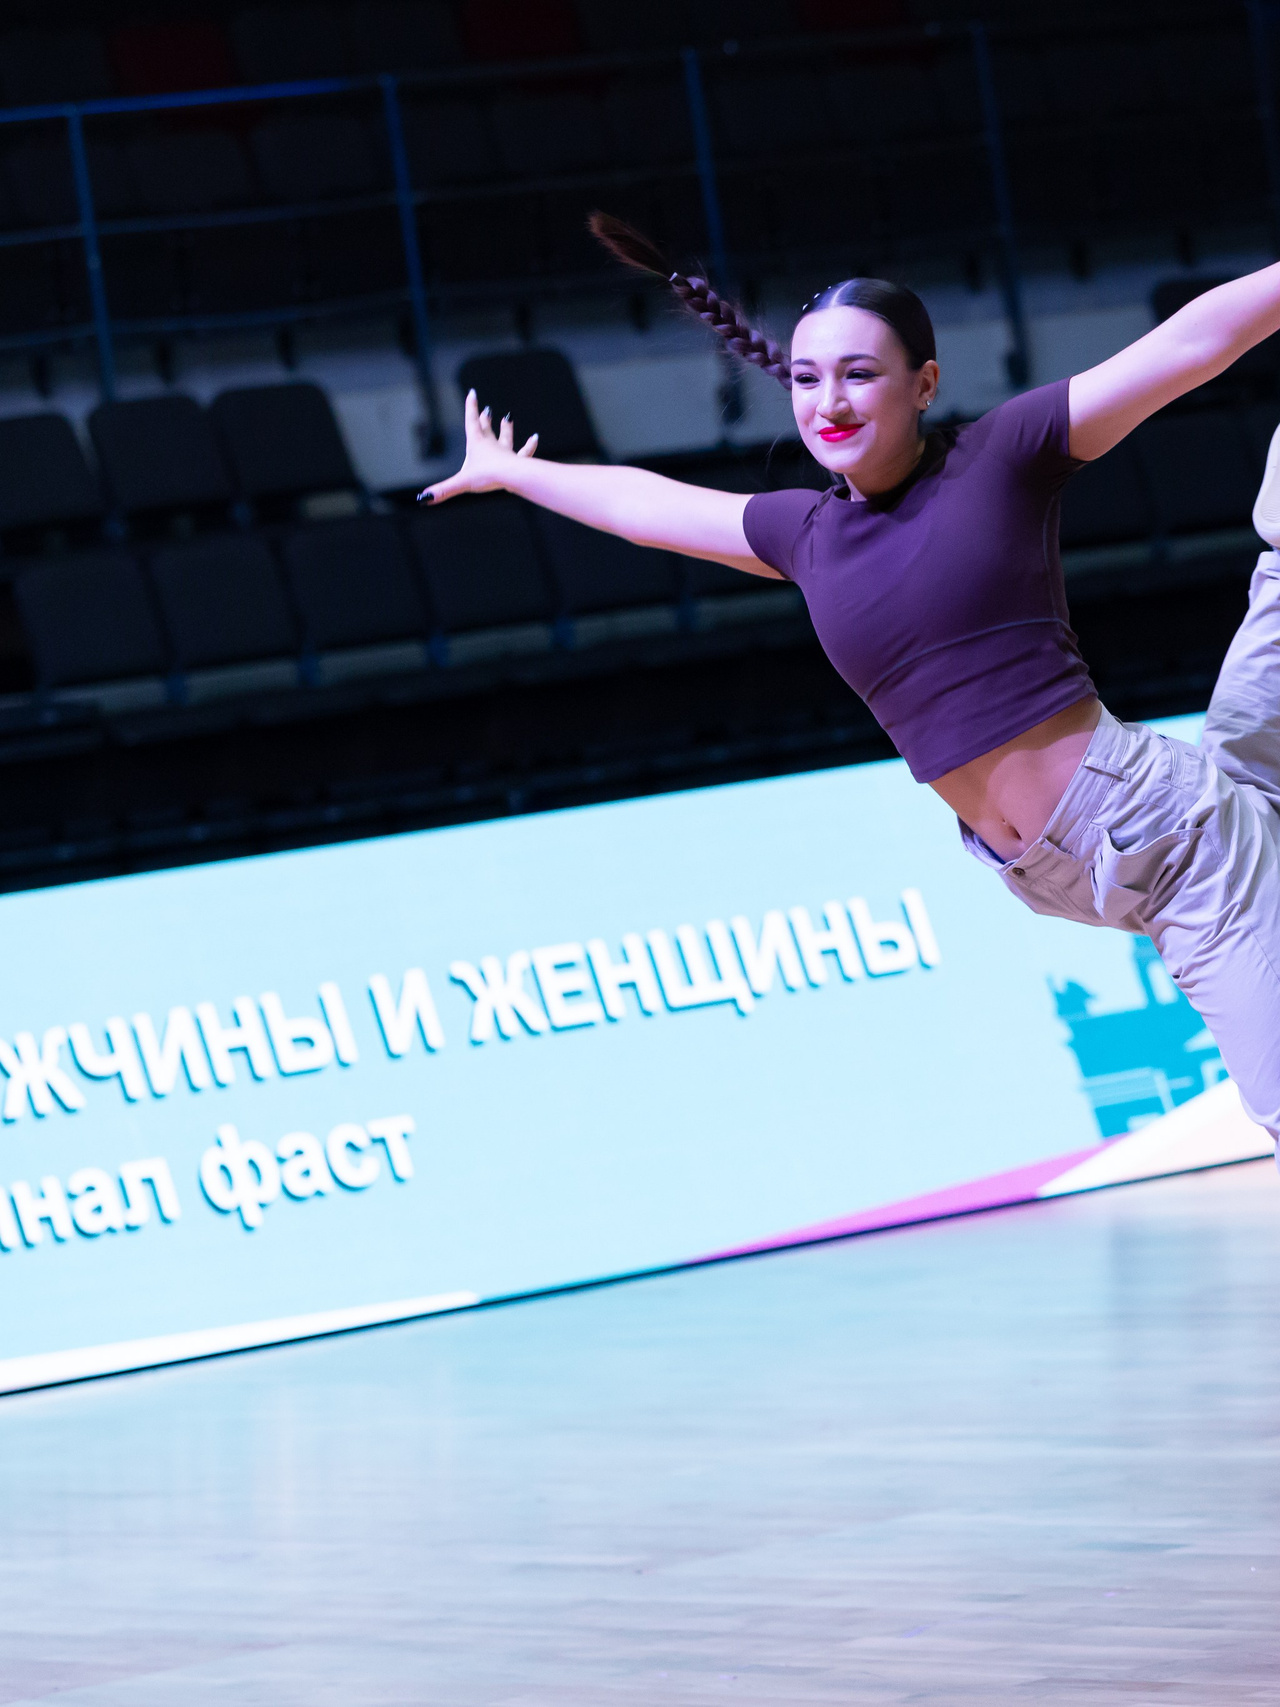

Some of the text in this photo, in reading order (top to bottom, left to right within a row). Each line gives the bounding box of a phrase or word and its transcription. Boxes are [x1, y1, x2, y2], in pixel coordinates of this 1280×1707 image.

[368, 967, 445, 1059] И
[448, 884, 942, 1047] ЖЕНЩИНЫ
[199, 1113, 416, 1231] фаст
